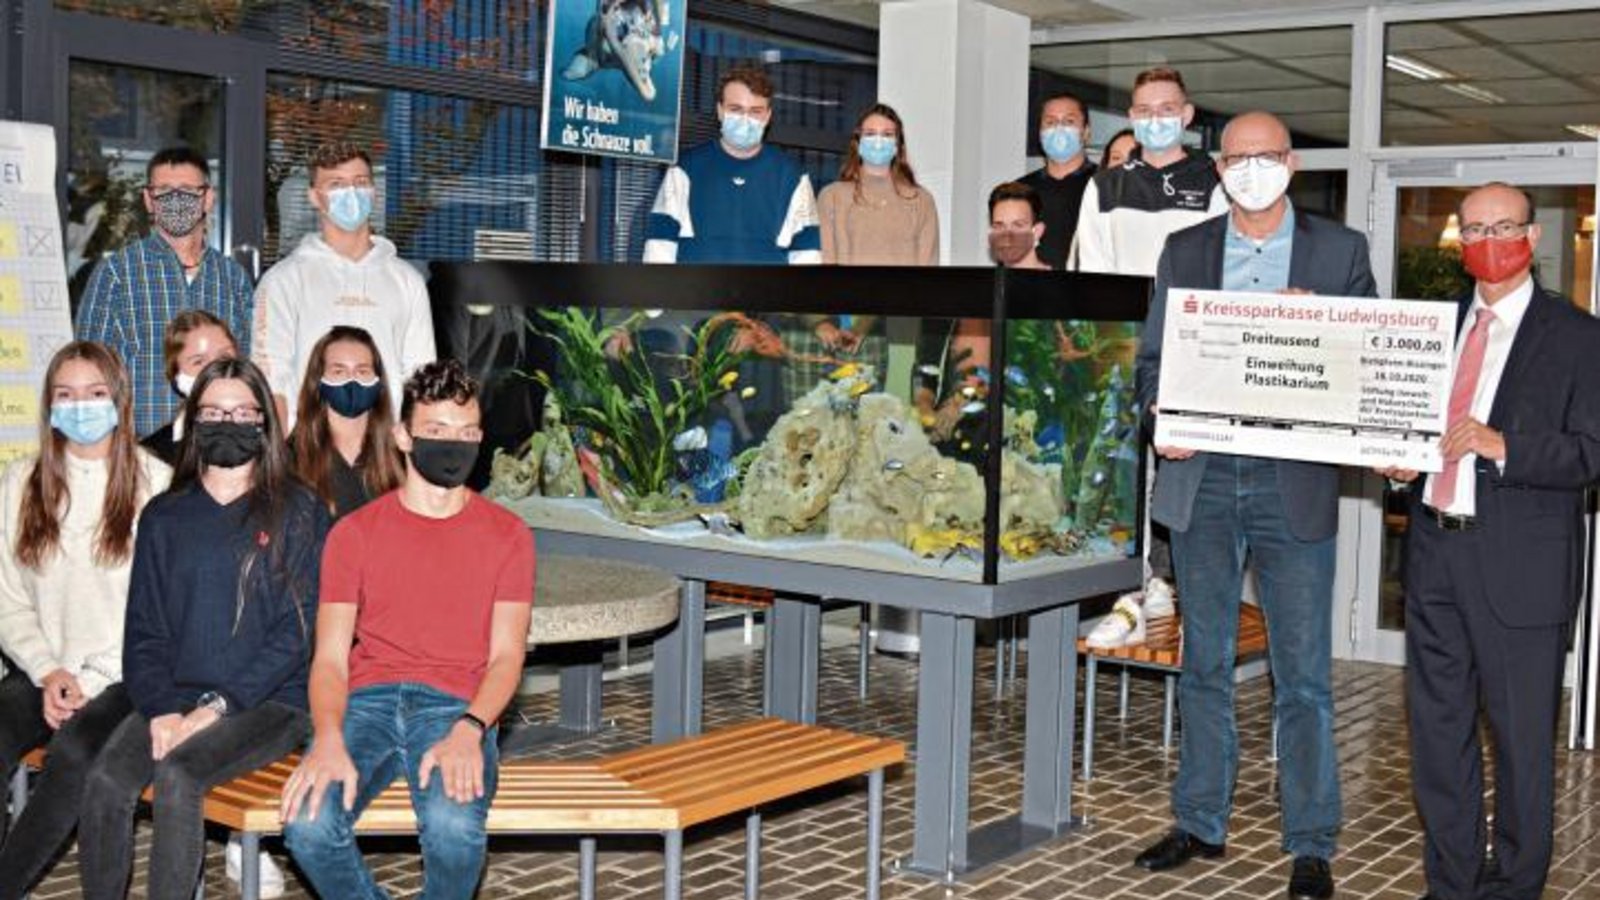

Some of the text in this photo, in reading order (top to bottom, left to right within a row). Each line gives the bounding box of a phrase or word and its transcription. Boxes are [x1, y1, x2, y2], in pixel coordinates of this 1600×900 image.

[564, 95, 619, 125] Wir haben
[562, 123, 655, 156] die Schnauze voll.
[1202, 300, 1324, 322] Kreissparkasse
[1328, 307, 1440, 332] Ludwigsburg
[1242, 331, 1320, 349] Dreitausend
[1386, 336, 1443, 353] 3.000,00
[1246, 356, 1325, 376] Einweihung
[1244, 372, 1331, 391] Plastikarium
